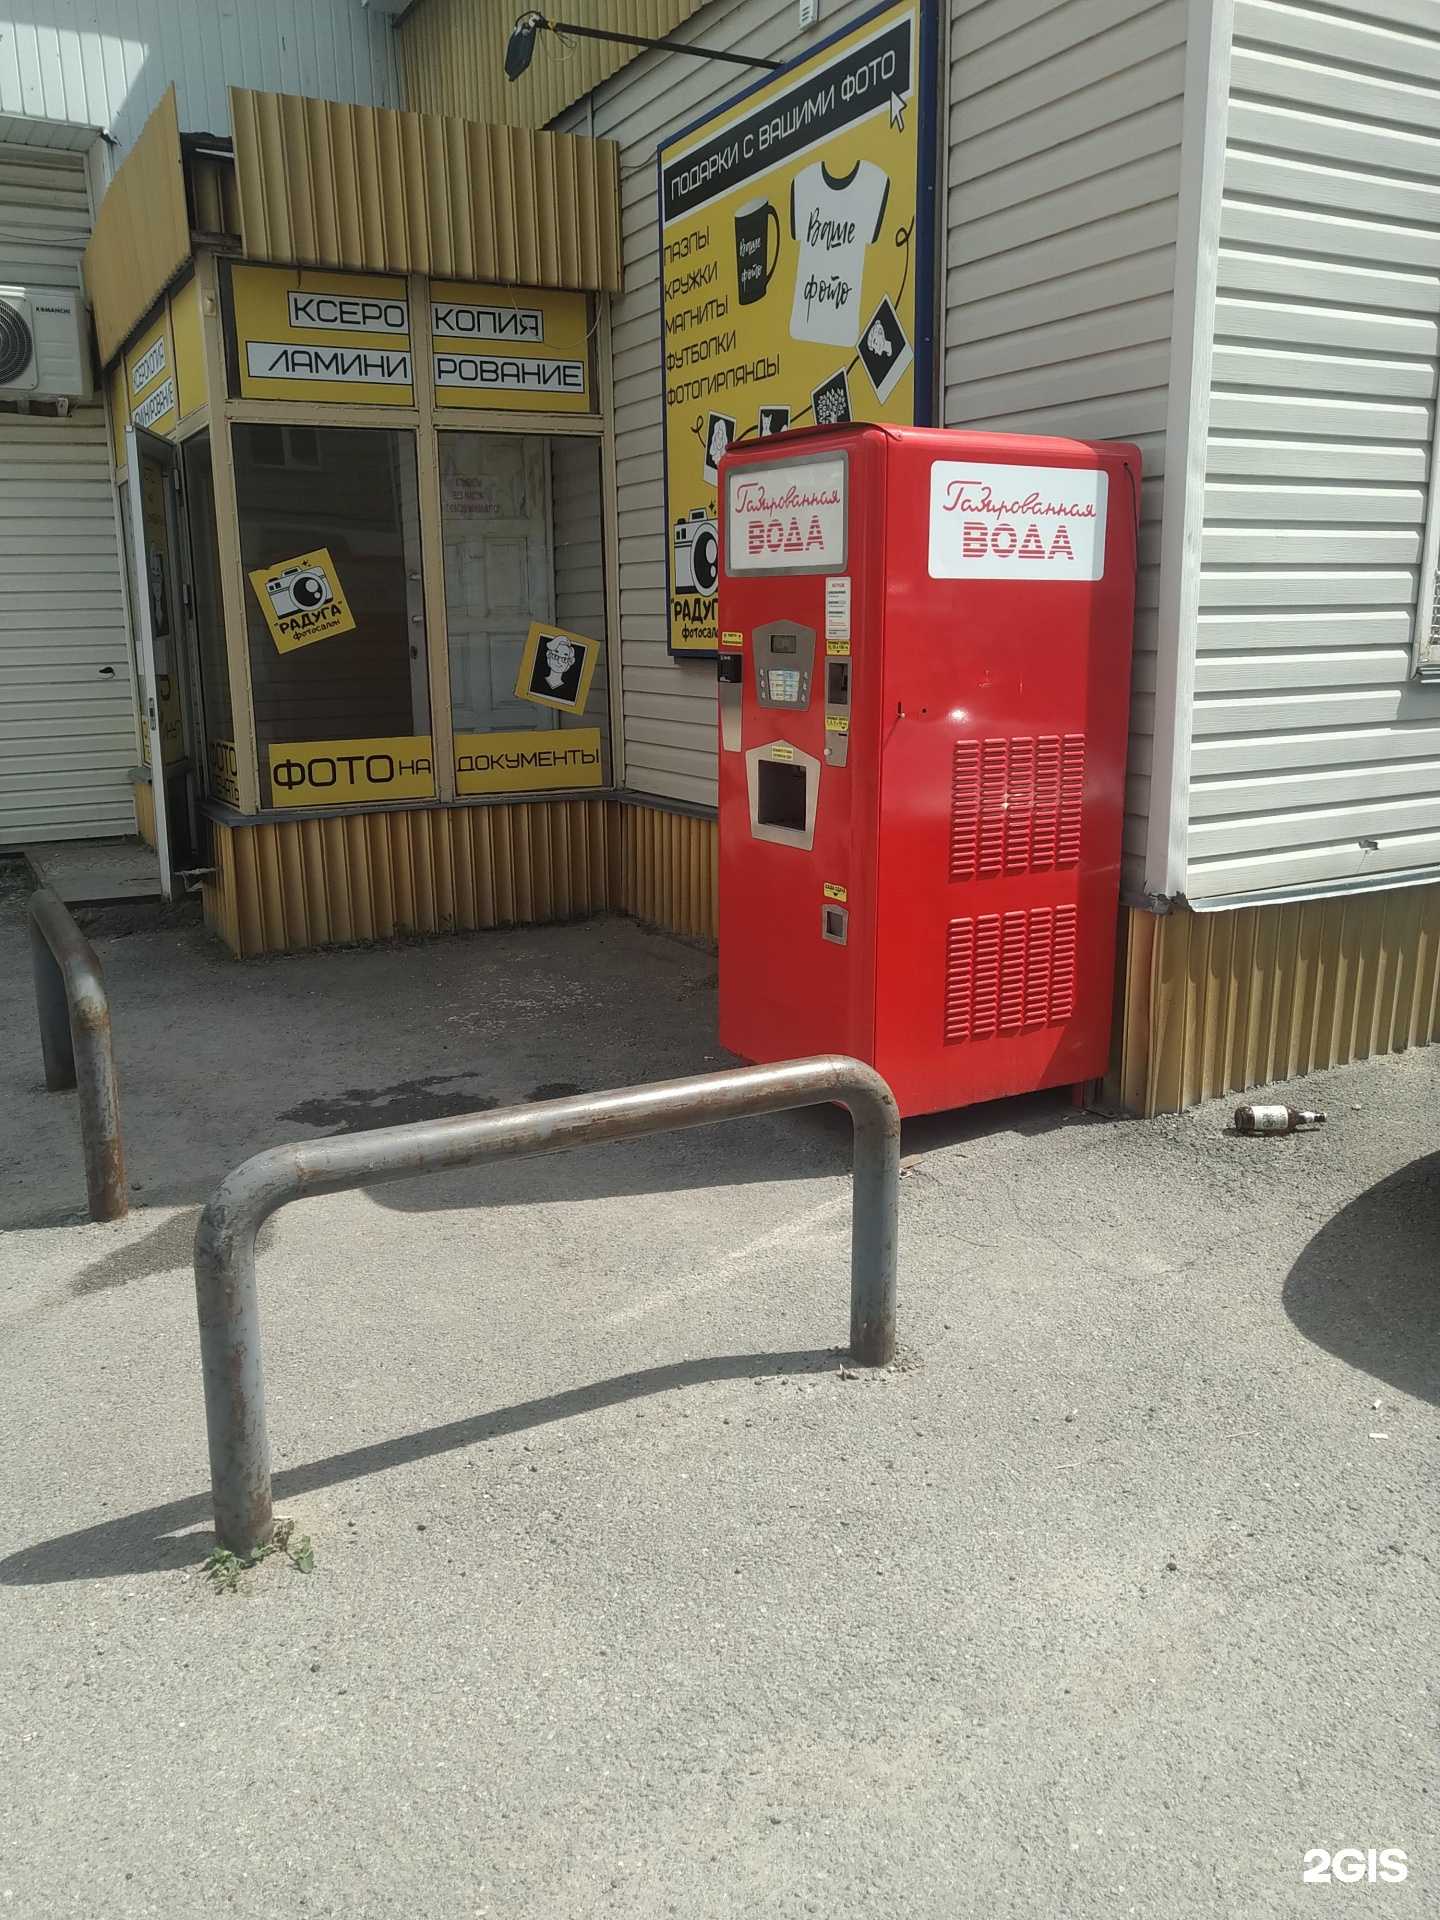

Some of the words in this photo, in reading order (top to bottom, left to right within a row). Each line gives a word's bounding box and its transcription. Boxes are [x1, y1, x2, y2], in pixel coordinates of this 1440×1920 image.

[671, 141, 739, 201] ПОДАРКИ
[743, 134, 754, 159] С
[758, 84, 835, 149] ВАШИМИ
[841, 50, 895, 102] ФОТО
[663, 226, 710, 266] ПАЗЛЫ
[806, 207, 856, 250] Ваше
[664, 261, 718, 302] КРУЖКИ
[803, 274, 852, 324] фото
[294, 297, 405, 328] КСЕРО
[434, 307, 540, 337] КОПИЯ
[665, 295, 728, 337] МАГНИТЫ
[268, 349, 408, 379] ЛАМИНИ
[437, 357, 583, 388] РОВАНИЕ
[666, 329, 737, 372] ФУТБОЛКИ
[667, 353, 781, 406] ФОТОГИРЛЯНДЫ
[735, 482, 841, 517] Газированная
[943, 480, 1097, 520] Газированная
[748, 514, 825, 555] ВОДА
[962, 521, 1075, 560] ВОДА
[293, 618, 341, 640] фотосалон
[671, 598, 718, 624] "РАДУГ
[273, 754, 395, 791] ФОТО
[399, 758, 432, 776] НА
[456, 748, 600, 773] ДОКУМЕНТЫ
